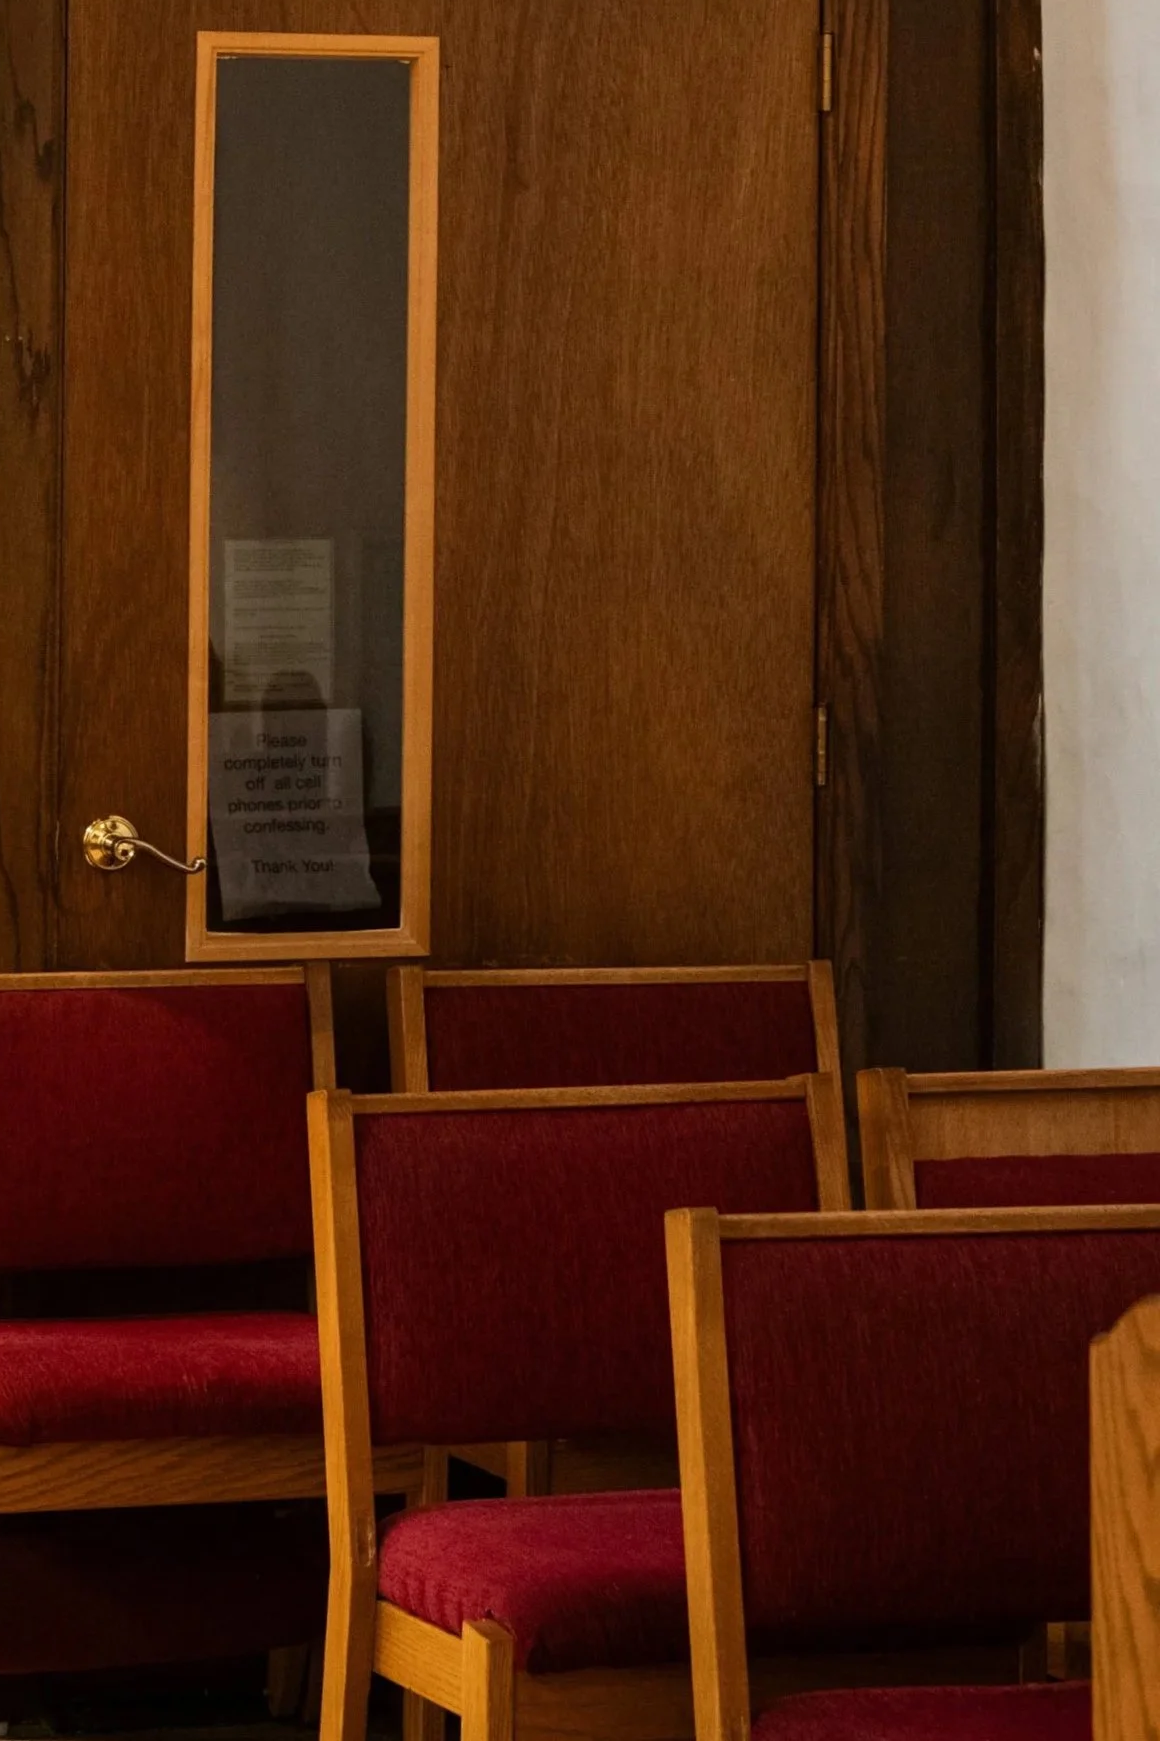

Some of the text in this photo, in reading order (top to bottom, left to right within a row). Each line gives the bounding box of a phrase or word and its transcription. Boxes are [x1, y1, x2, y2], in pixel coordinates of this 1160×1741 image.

[256, 733, 307, 748] Please
[224, 755, 342, 772] completely turn
[246, 775, 321, 791] off all cell
[228, 799, 283, 815] phones
[286, 798, 321, 812] prior
[244, 818, 330, 835] confessing.
[251, 858, 335, 874] Thank You!
